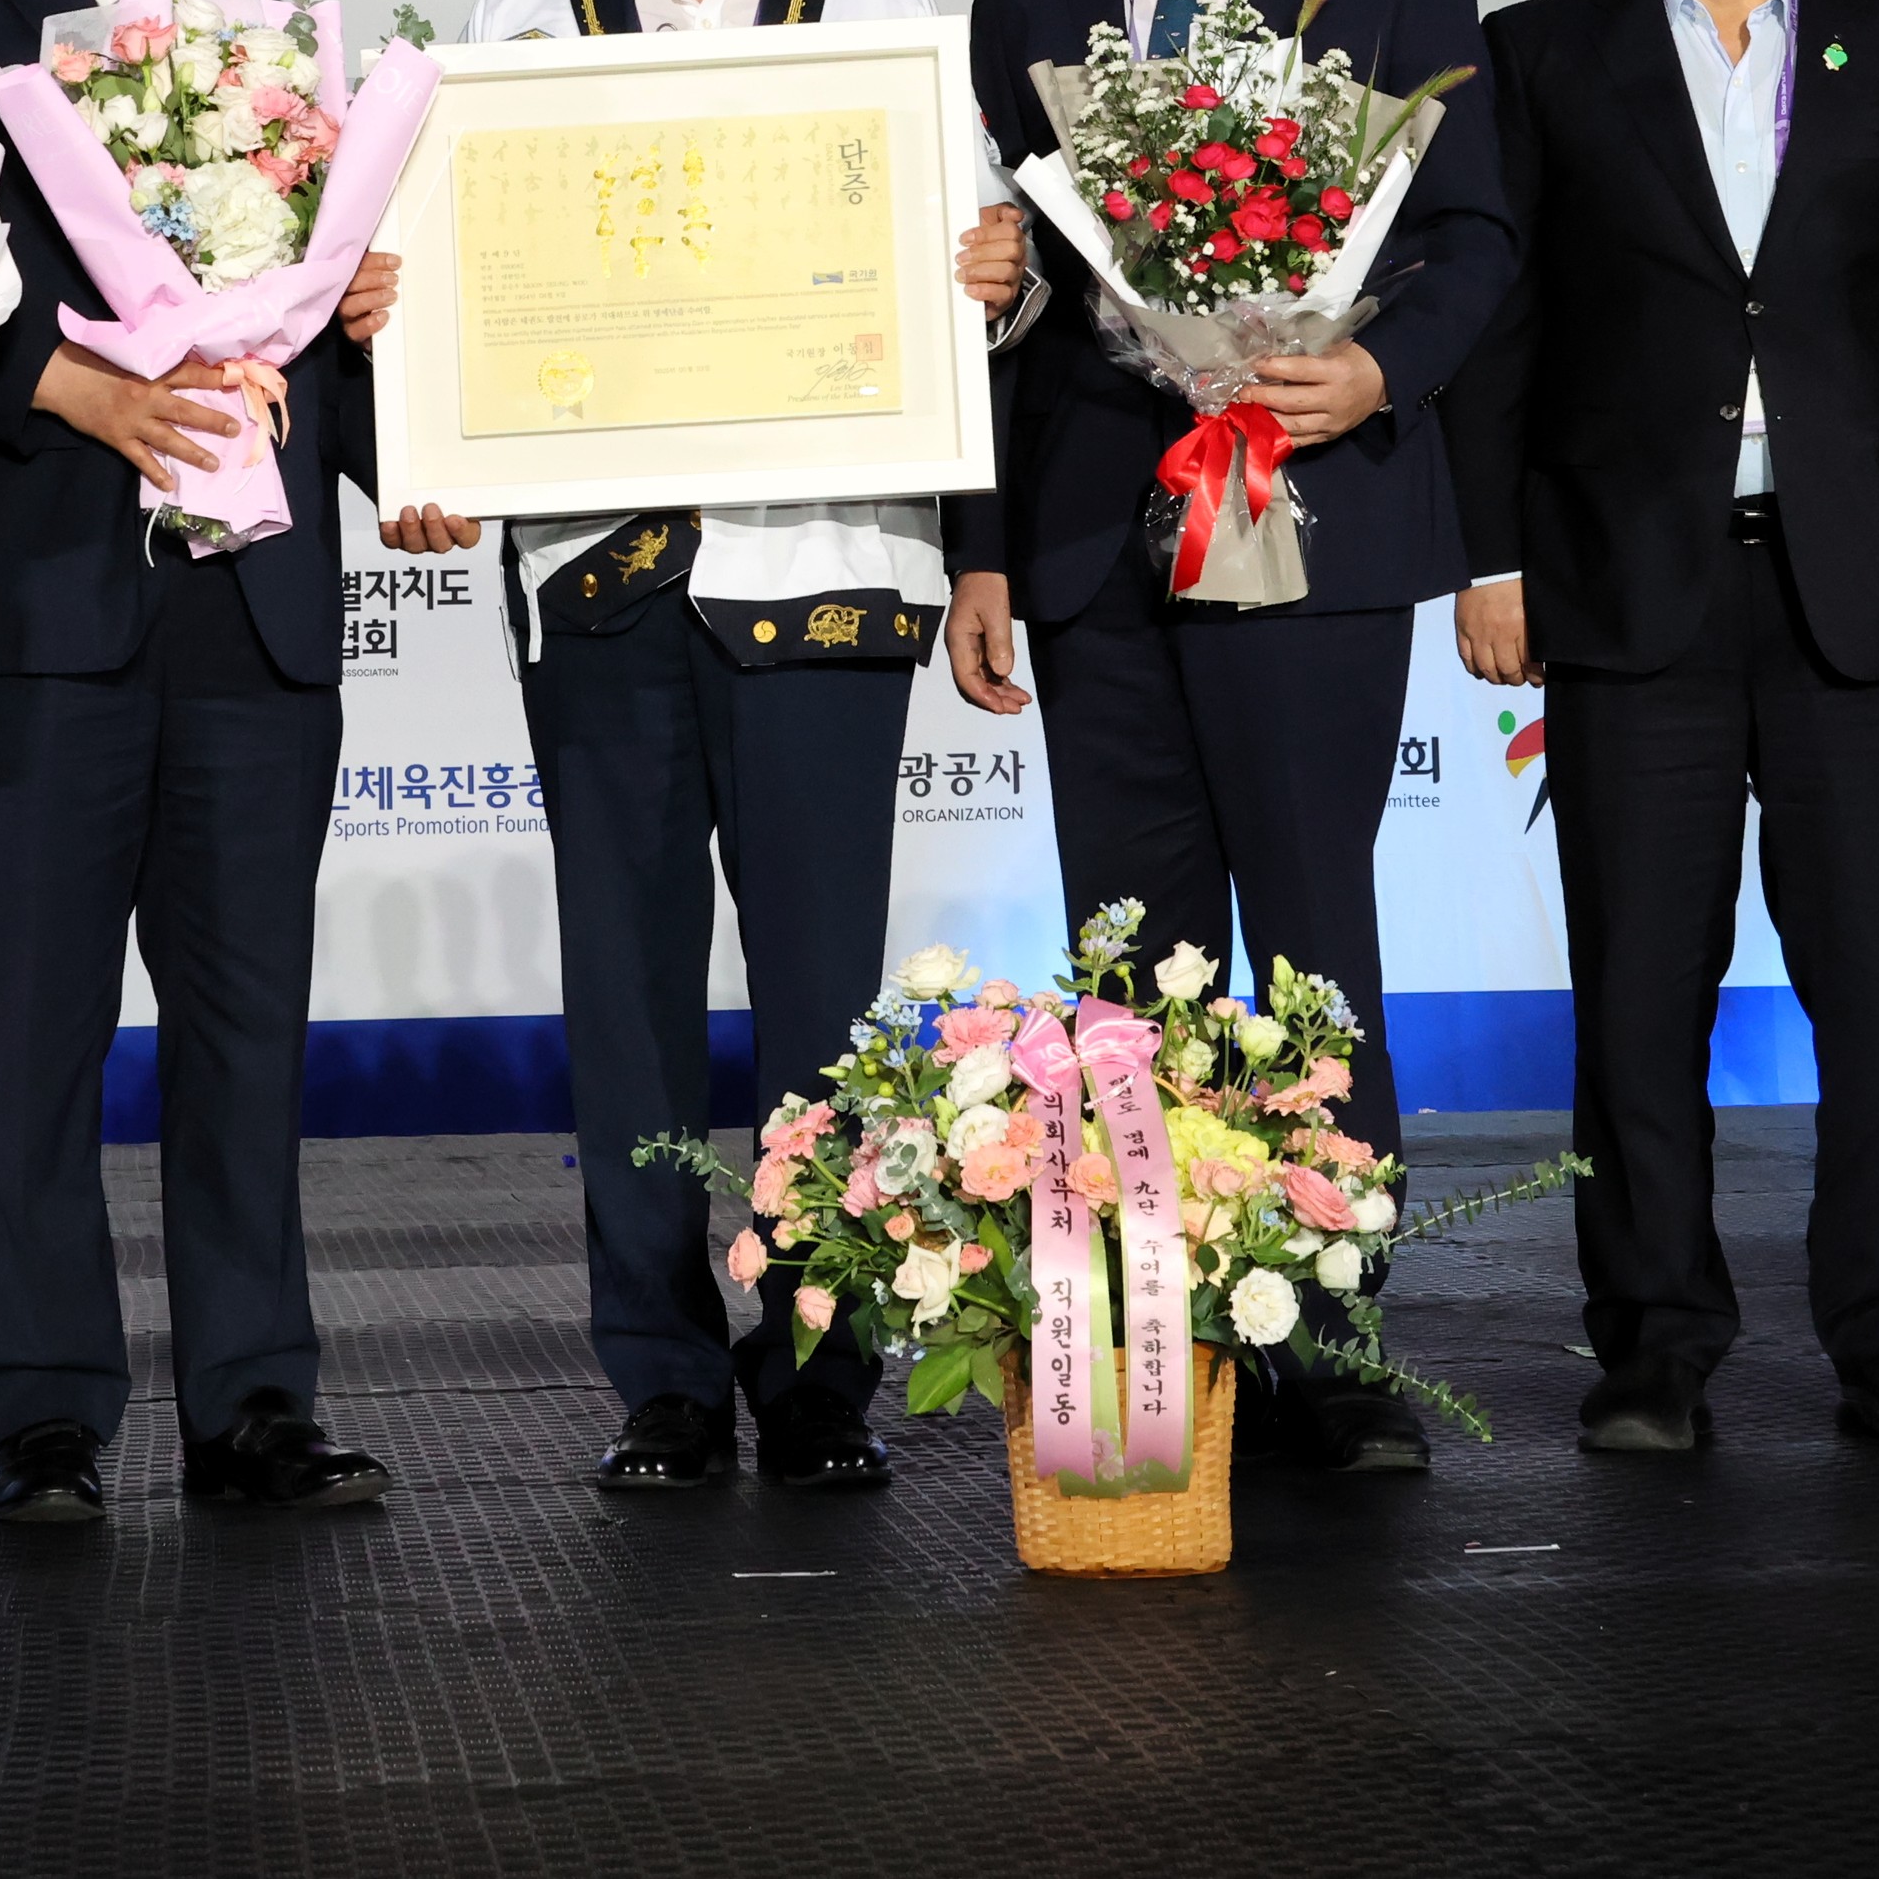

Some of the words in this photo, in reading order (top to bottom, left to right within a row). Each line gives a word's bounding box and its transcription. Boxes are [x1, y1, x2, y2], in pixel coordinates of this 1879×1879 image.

[837, 138, 871, 205] 단증
[333, 817, 390, 841] Sports
[396, 815, 490, 836] Promotion
[902, 806, 1024, 823] ORGANIZATION
[1049, 1276, 1077, 1426] 직원일동
[1141, 1318, 1168, 1417] 축하합니다
